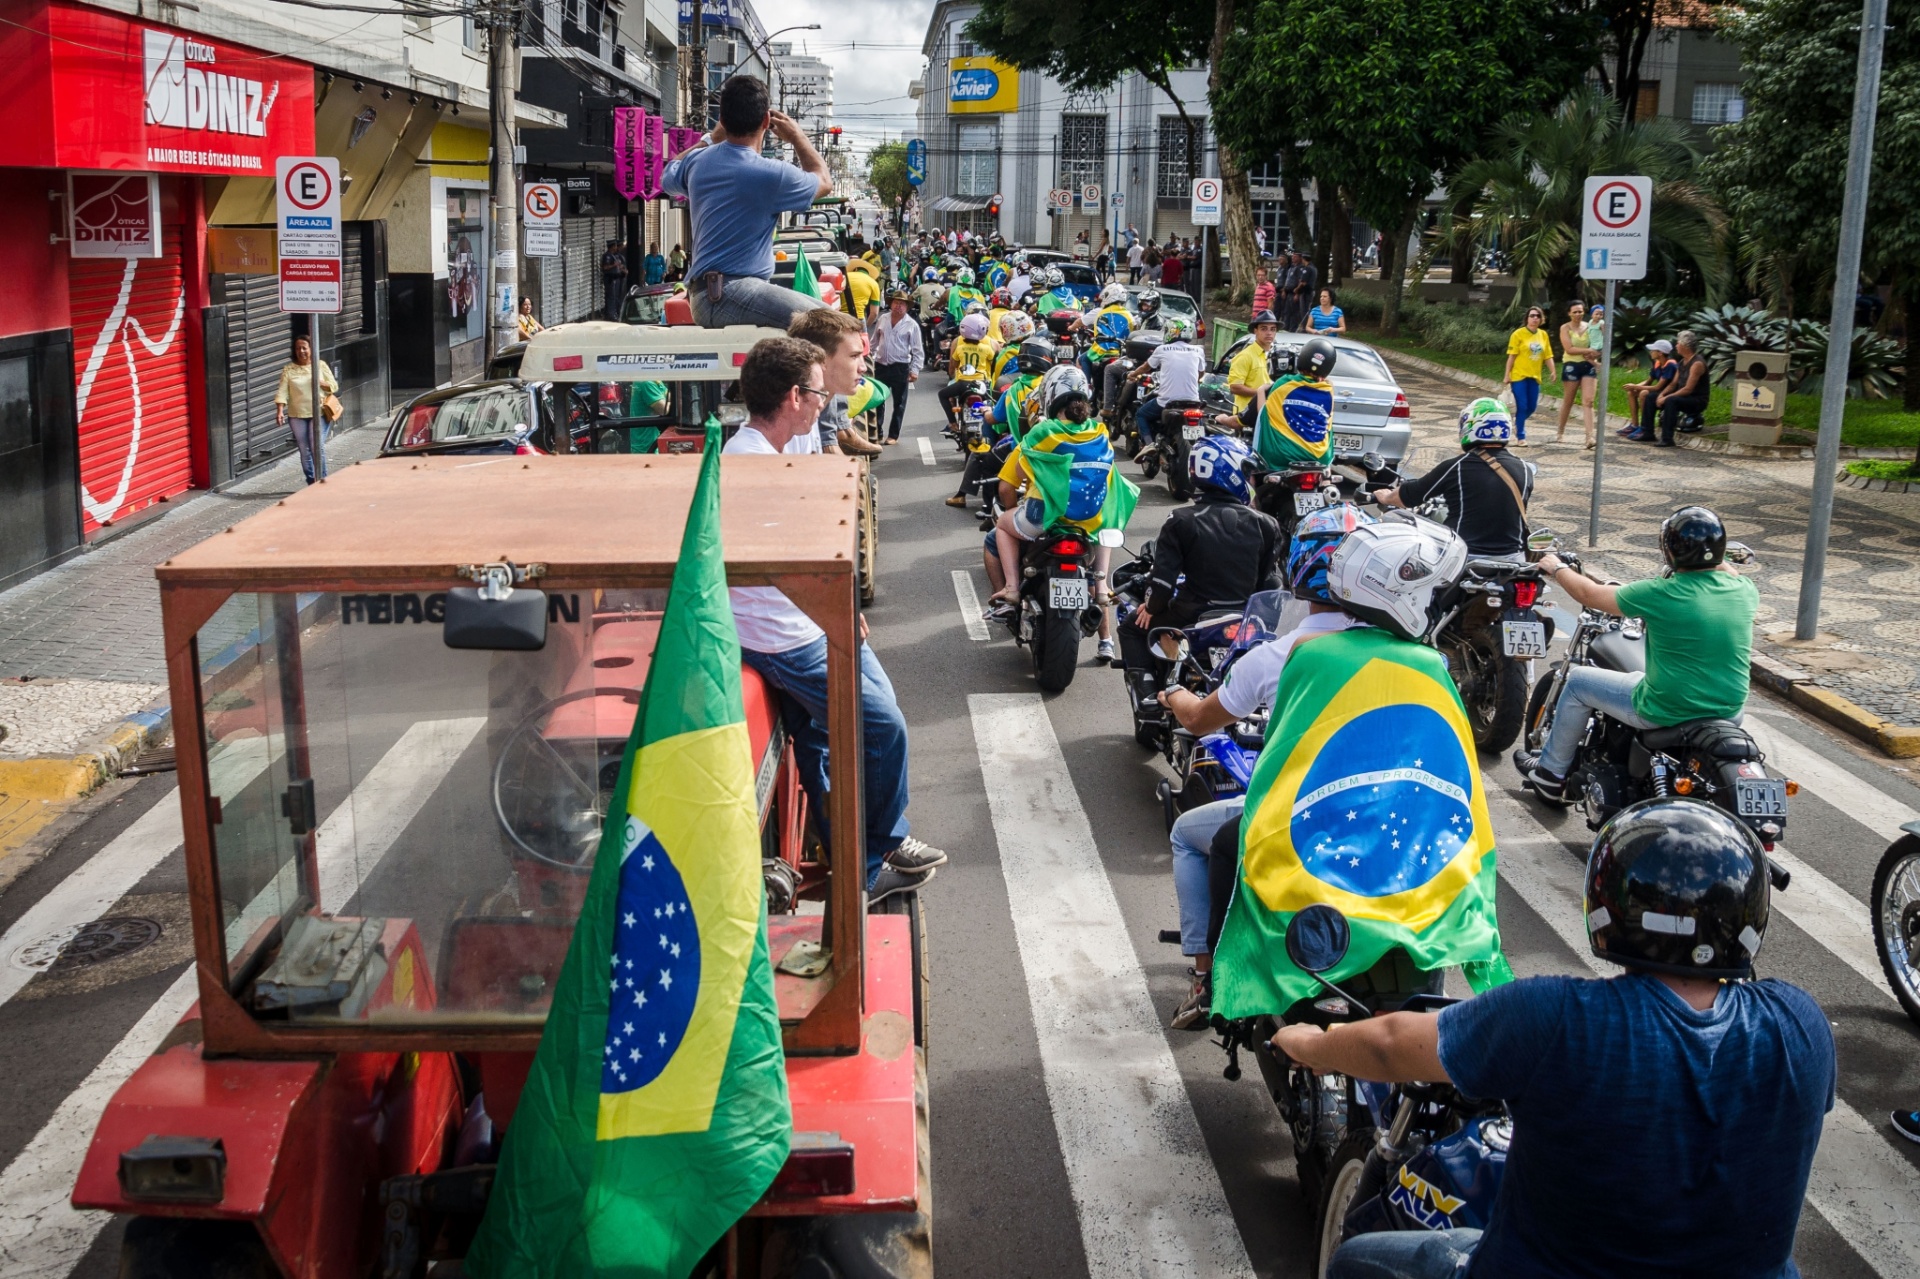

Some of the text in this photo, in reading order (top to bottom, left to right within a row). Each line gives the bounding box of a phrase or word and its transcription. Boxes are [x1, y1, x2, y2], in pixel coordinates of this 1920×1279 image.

[186, 37, 215, 64] ÓTICAS
[950, 71, 992, 100] Xavier
[186, 67, 264, 137] DINIZ
[148, 147, 263, 170] A MAIOR REDE DE ÓTICAS DO BRASIL
[301, 172, 318, 200] E
[567, 180, 591, 188] Botto
[1088, 188, 1095, 198] E
[1203, 185, 1212, 198] E
[536, 192, 549, 211] E
[1061, 194, 1068, 203] E
[1609, 191, 1627, 218] E
[117, 218, 146, 226] ÓTICAS
[288, 218, 330, 227] ÁREA AZUL
[75, 228, 150, 242] DINIZ
[607, 354, 676, 365] AGRITECH
[963, 352, 980, 370] 10
[1298, 498, 1320, 507] EWZ
[1055, 586, 1082, 597] DVX
[1053, 596, 1084, 607] 8090
[1509, 630, 1539, 643] FAT
[1508, 642, 1542, 656] 7672
[1215, 782, 1238, 791] YAMAHA
[1306, 777, 1360, 804] ORDEM
[1382, 770, 1462, 798] PROGRESSO
[1744, 801, 1782, 815] 8512
